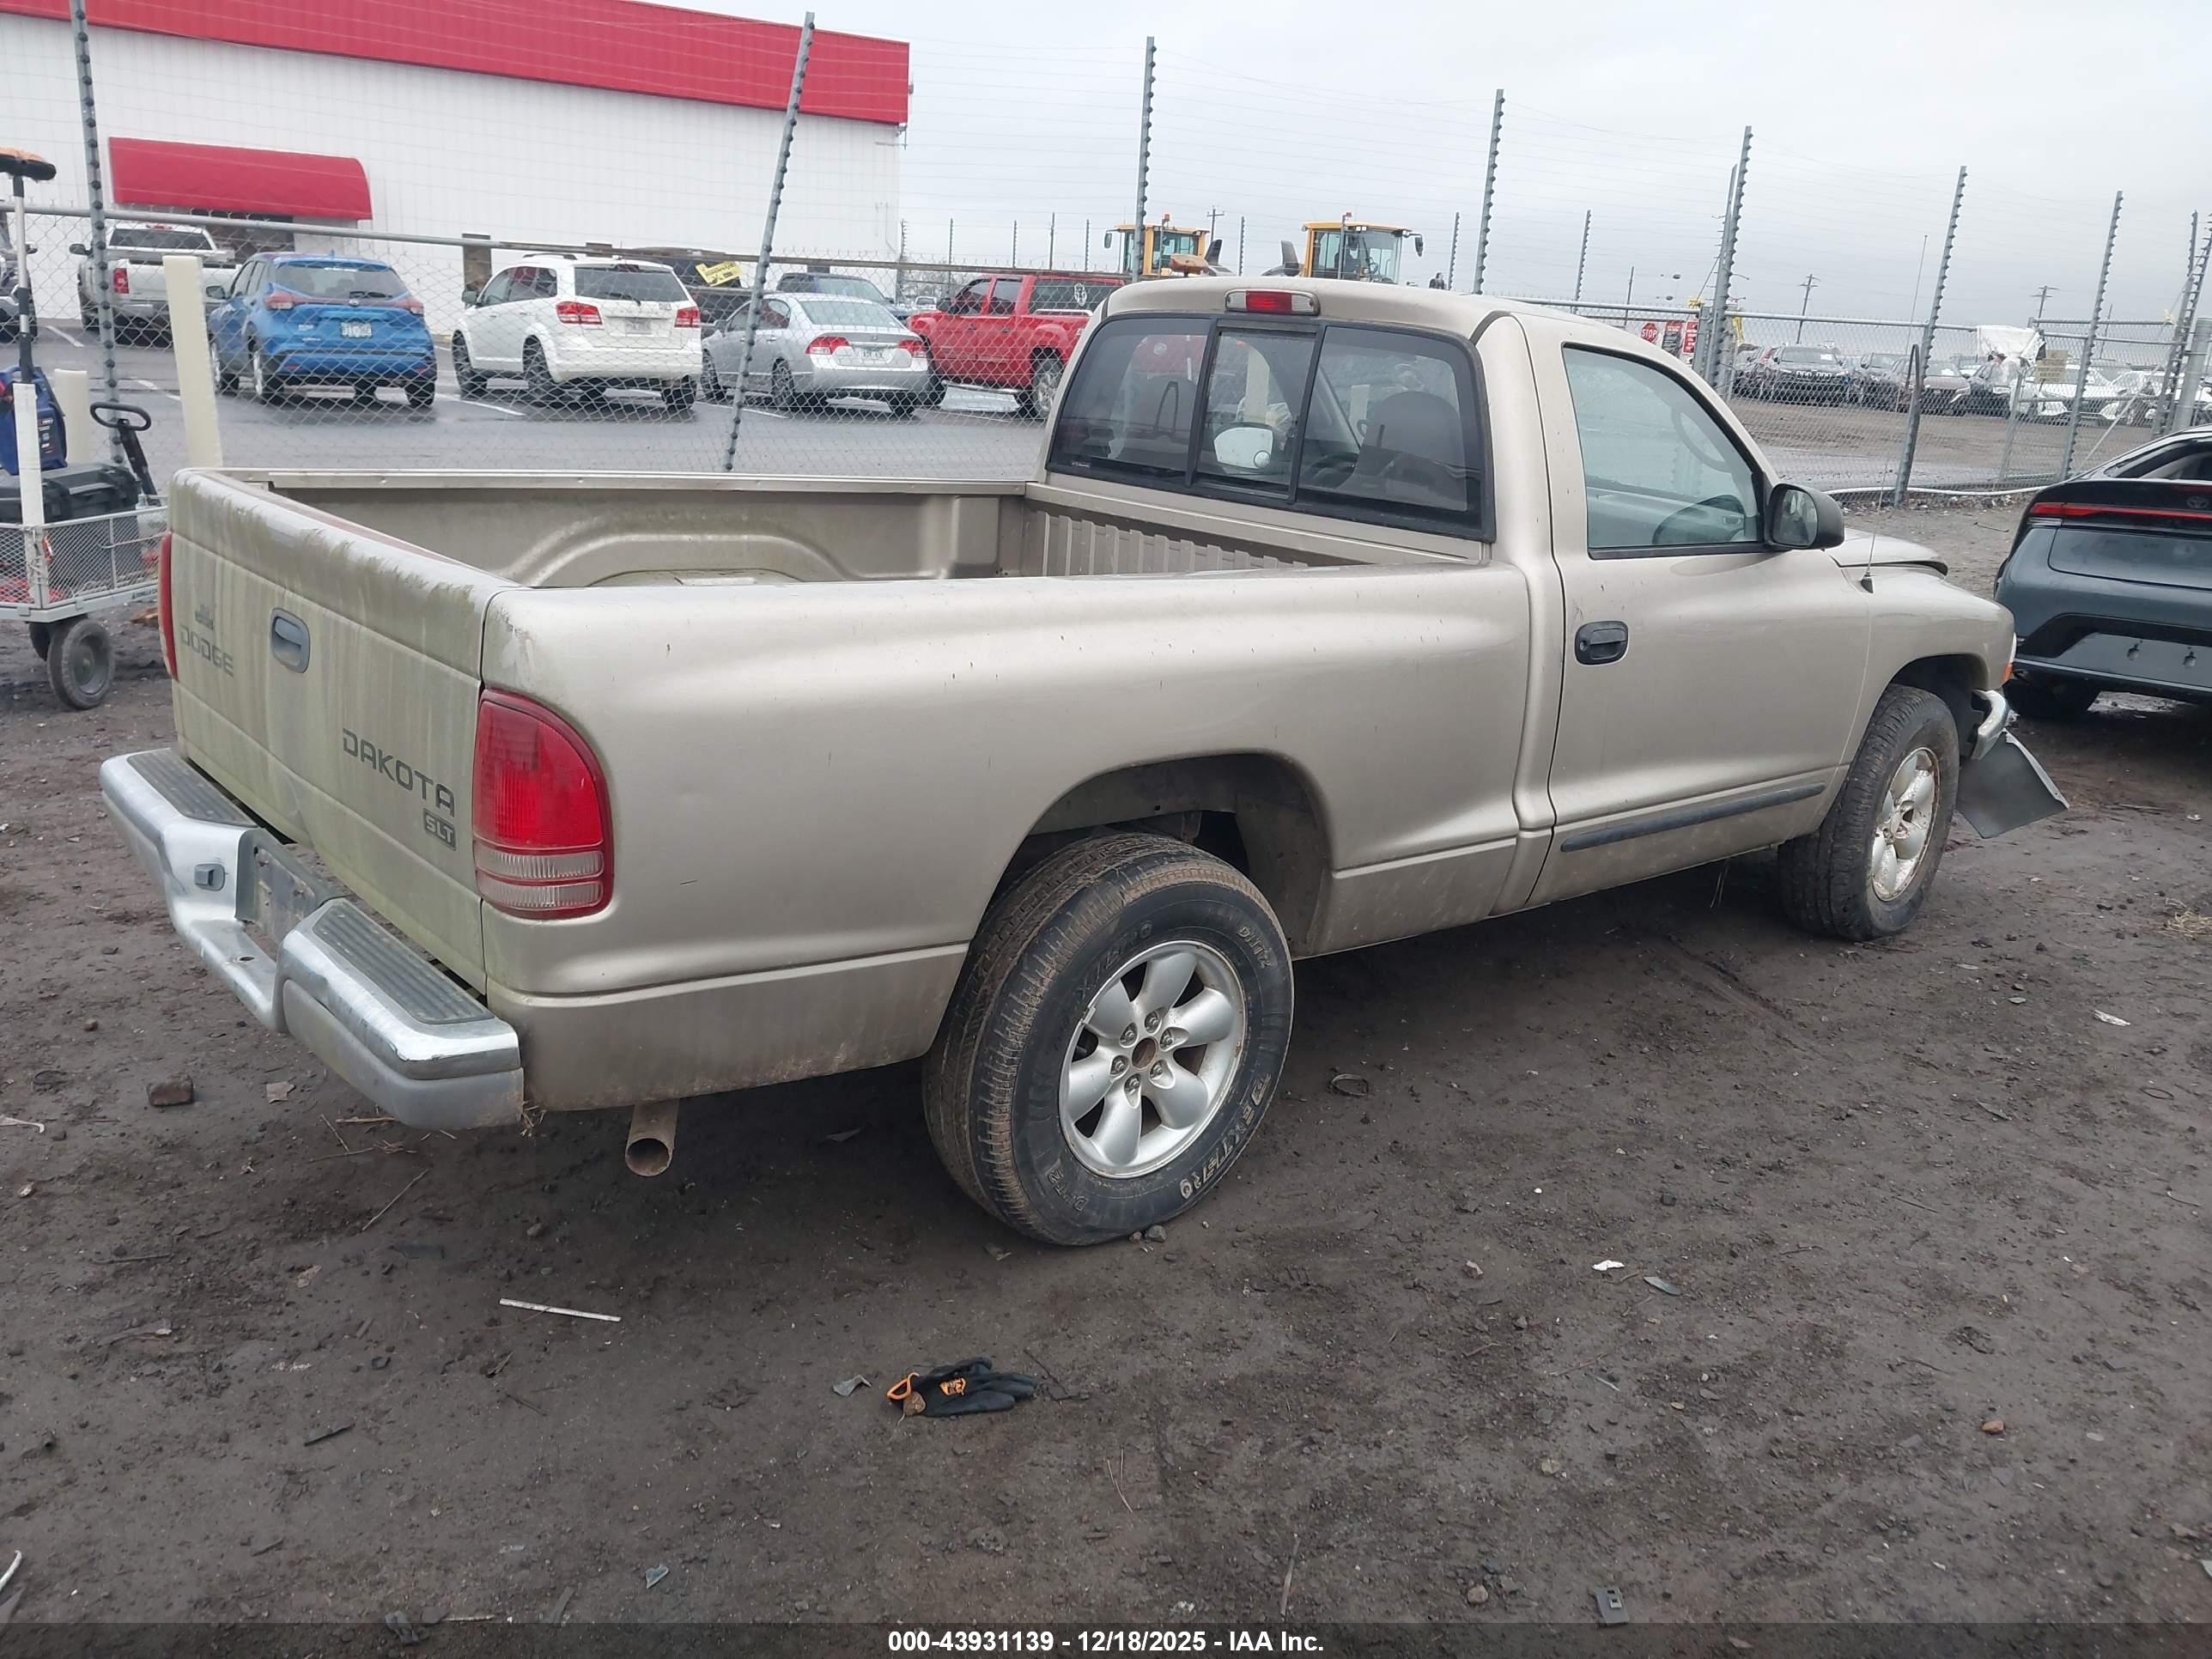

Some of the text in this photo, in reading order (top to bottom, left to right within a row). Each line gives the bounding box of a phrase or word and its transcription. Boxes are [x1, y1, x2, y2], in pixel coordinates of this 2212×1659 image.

[1641, 329, 1658, 338] STOP
[180, 623, 234, 678] DODGE
[343, 727, 456, 818] DAKOTA
[425, 815, 455, 845] SLT
